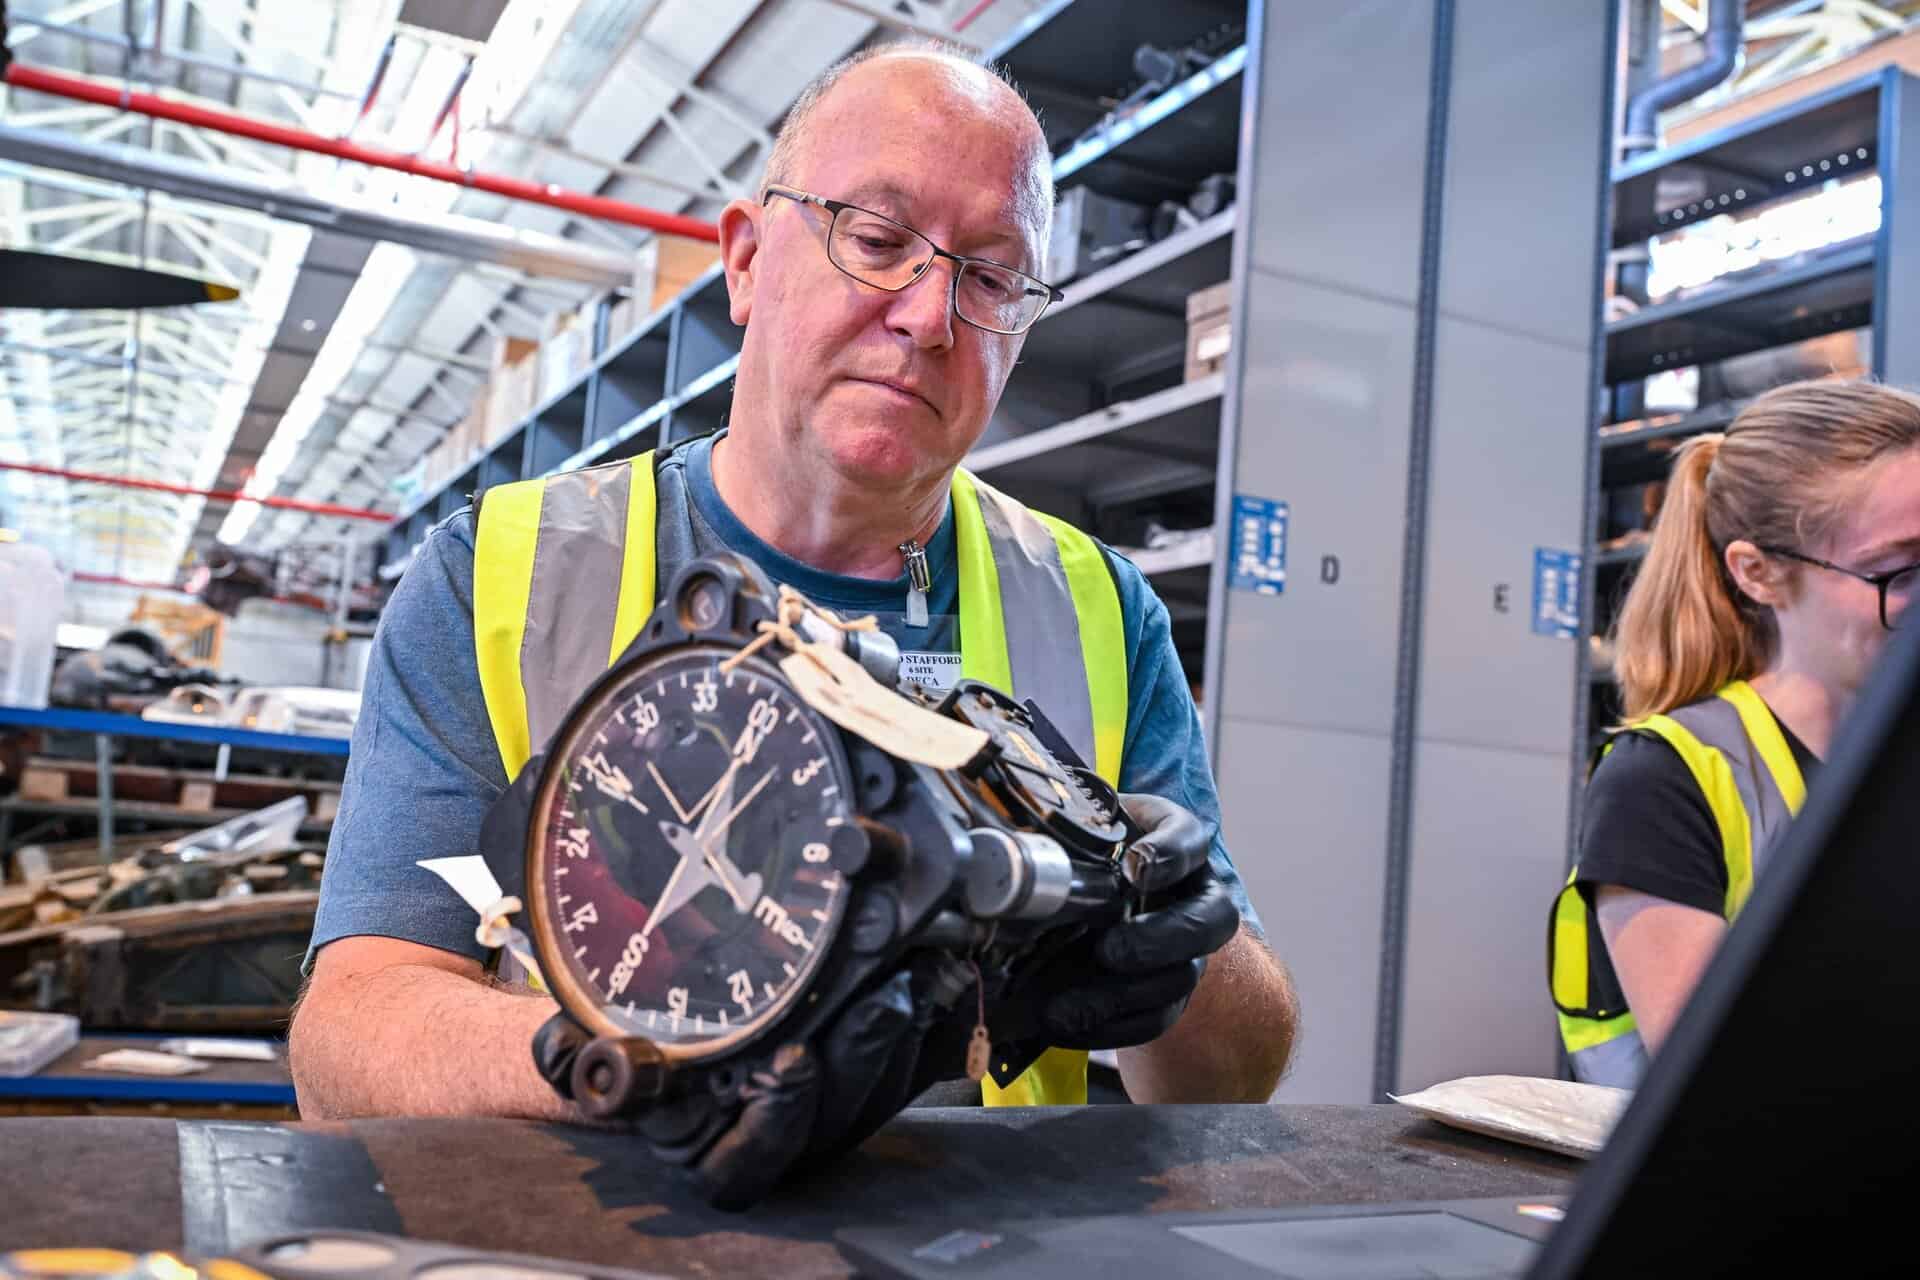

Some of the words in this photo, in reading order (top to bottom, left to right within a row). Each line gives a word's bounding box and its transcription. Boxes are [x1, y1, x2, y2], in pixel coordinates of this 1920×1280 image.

[1321, 556, 1340, 585] D
[1494, 583, 1510, 614] E
[905, 655, 962, 664] STAFFORD
[691, 682, 718, 712] 33
[630, 701, 660, 736] 30
[732, 724, 766, 764] N
[792, 759, 818, 786] 3
[566, 827, 591, 859] 24
[572, 902, 599, 932] 21
[754, 895, 788, 934] E
[622, 932, 650, 969] S
[609, 961, 635, 995] 18
[727, 968, 754, 1004] 12
[667, 986, 689, 1018] 15
